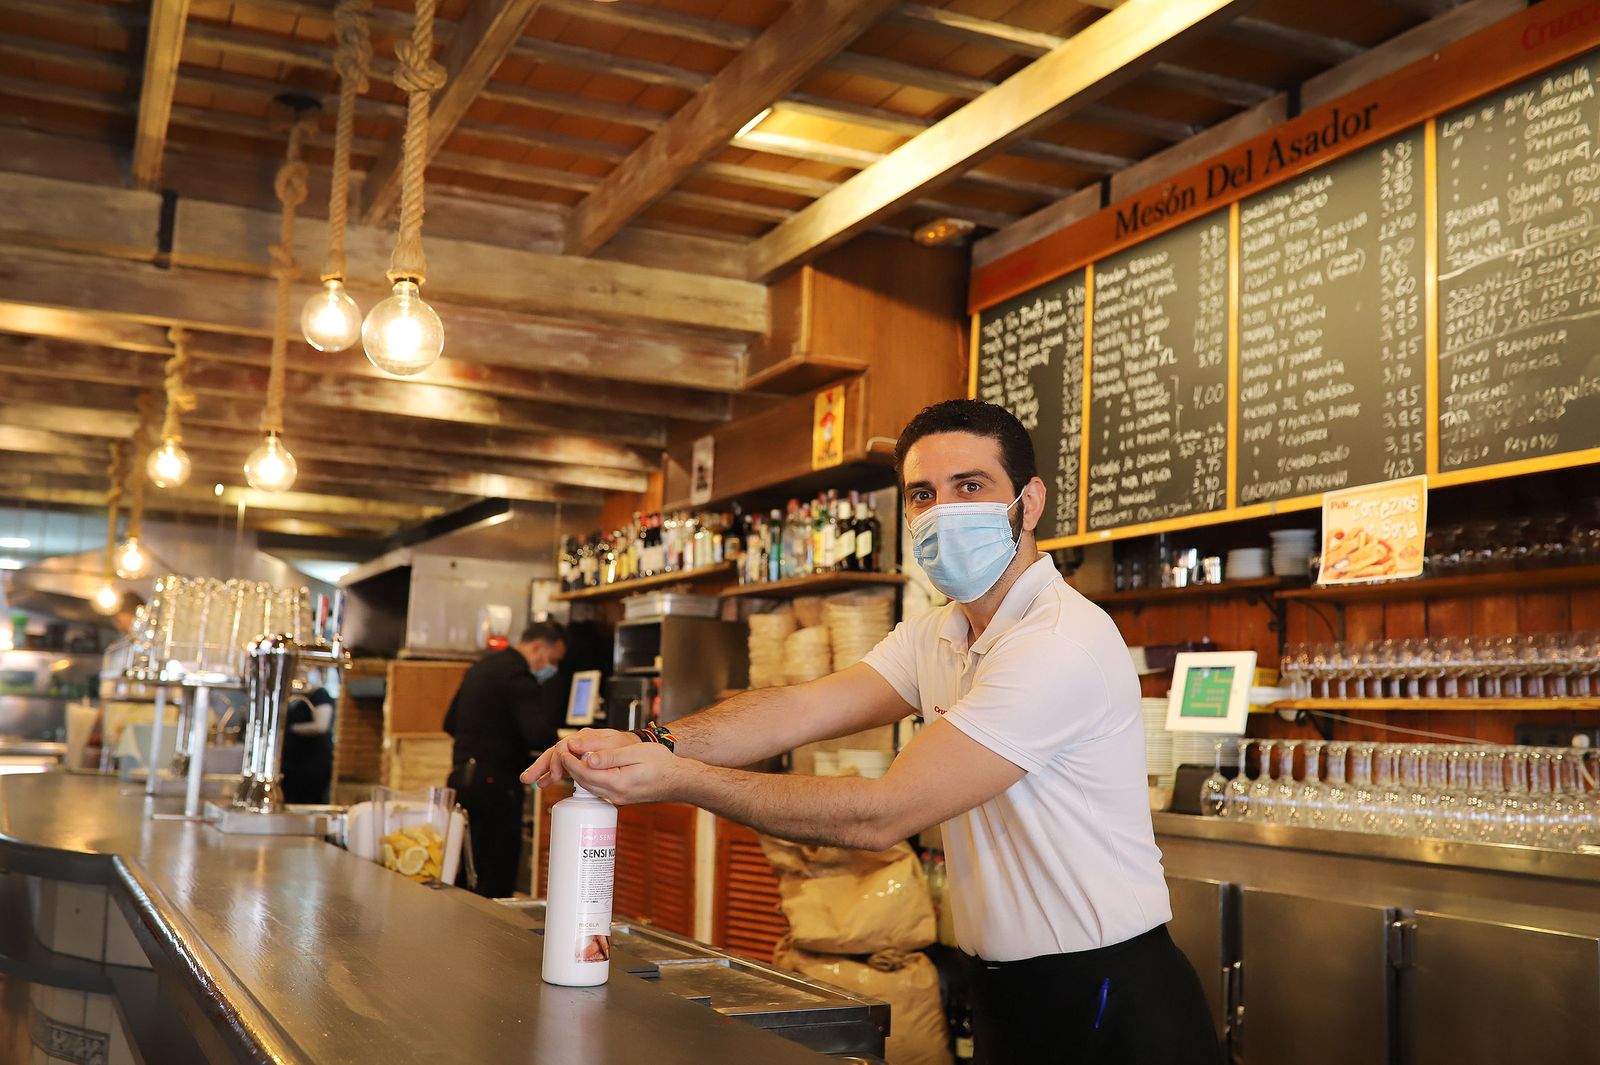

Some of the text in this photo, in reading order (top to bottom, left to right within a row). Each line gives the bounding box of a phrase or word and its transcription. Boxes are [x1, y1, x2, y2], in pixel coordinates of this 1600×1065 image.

[1115, 184, 1196, 241] Mesón
[1207, 150, 1252, 199] Del
[1264, 102, 1379, 176] Asador
[582, 848, 607, 858] SENSI
